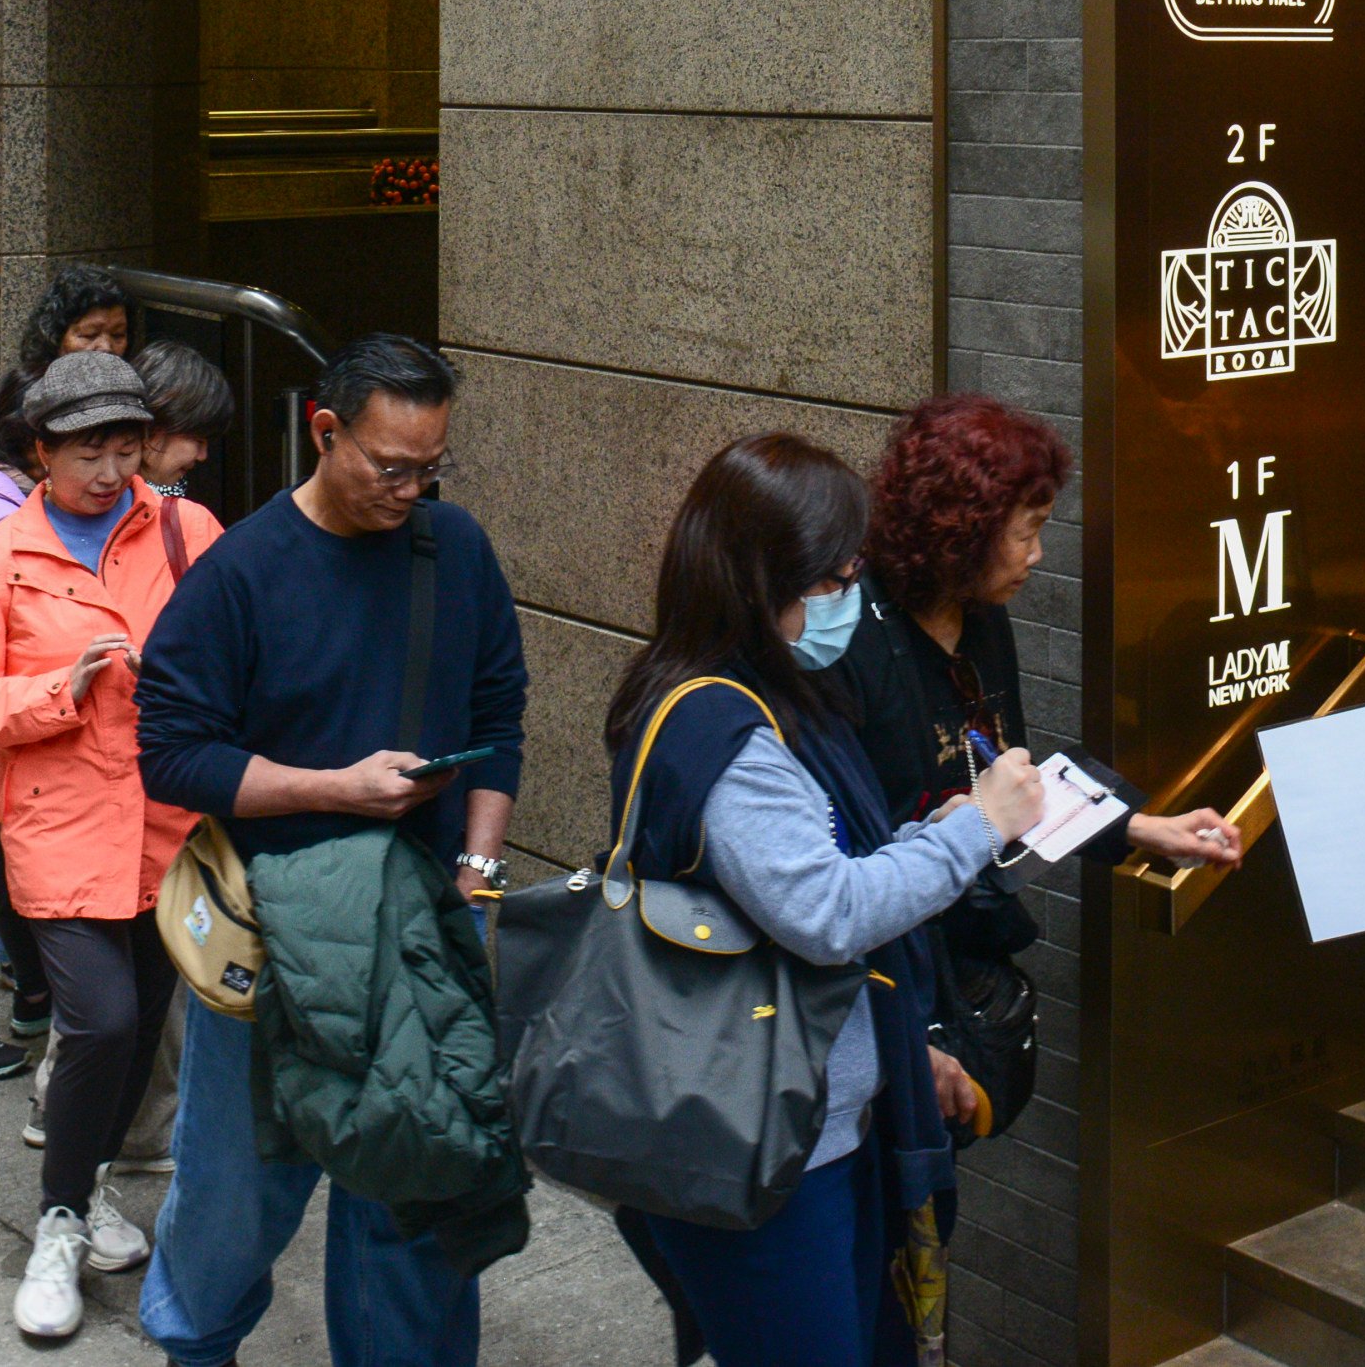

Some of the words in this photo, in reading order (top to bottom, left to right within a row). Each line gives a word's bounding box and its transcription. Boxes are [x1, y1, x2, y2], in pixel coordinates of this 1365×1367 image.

[1227, 123, 1277, 164] 2F
[1215, 256, 1285, 291] TIC
[1215, 305, 1285, 340] TAC
[1215, 349, 1286, 373] ROOM
[1226, 455, 1276, 500] 1F
[1209, 509, 1292, 623] M
[1208, 682, 1245, 708] NEW
[1246, 672, 1291, 699] YORK
